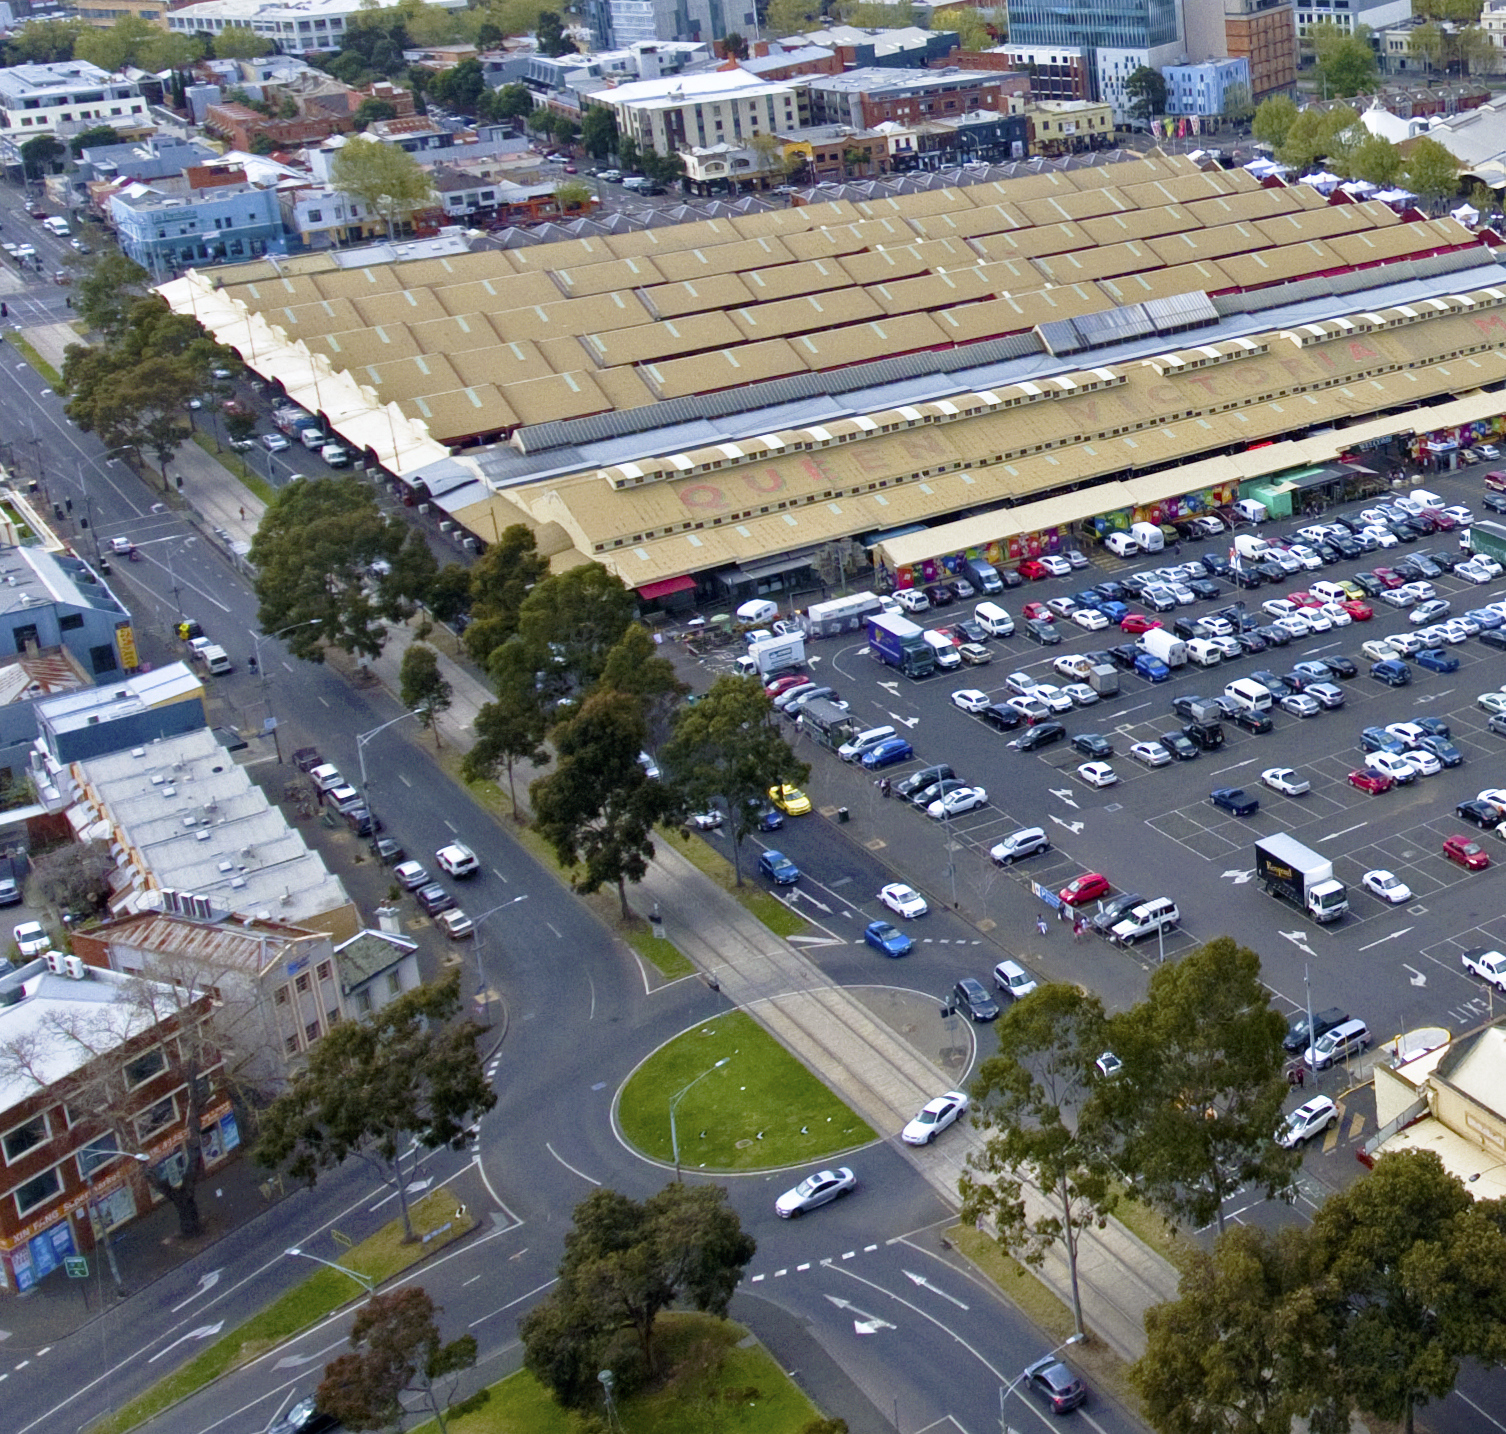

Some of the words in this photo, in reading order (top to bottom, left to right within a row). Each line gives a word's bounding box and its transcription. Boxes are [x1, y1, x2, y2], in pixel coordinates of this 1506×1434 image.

[679, 434, 946, 509] QUEEN
[1067, 343, 1379, 421] VICTORIA
[13, 1228, 30, 1244] XIN
